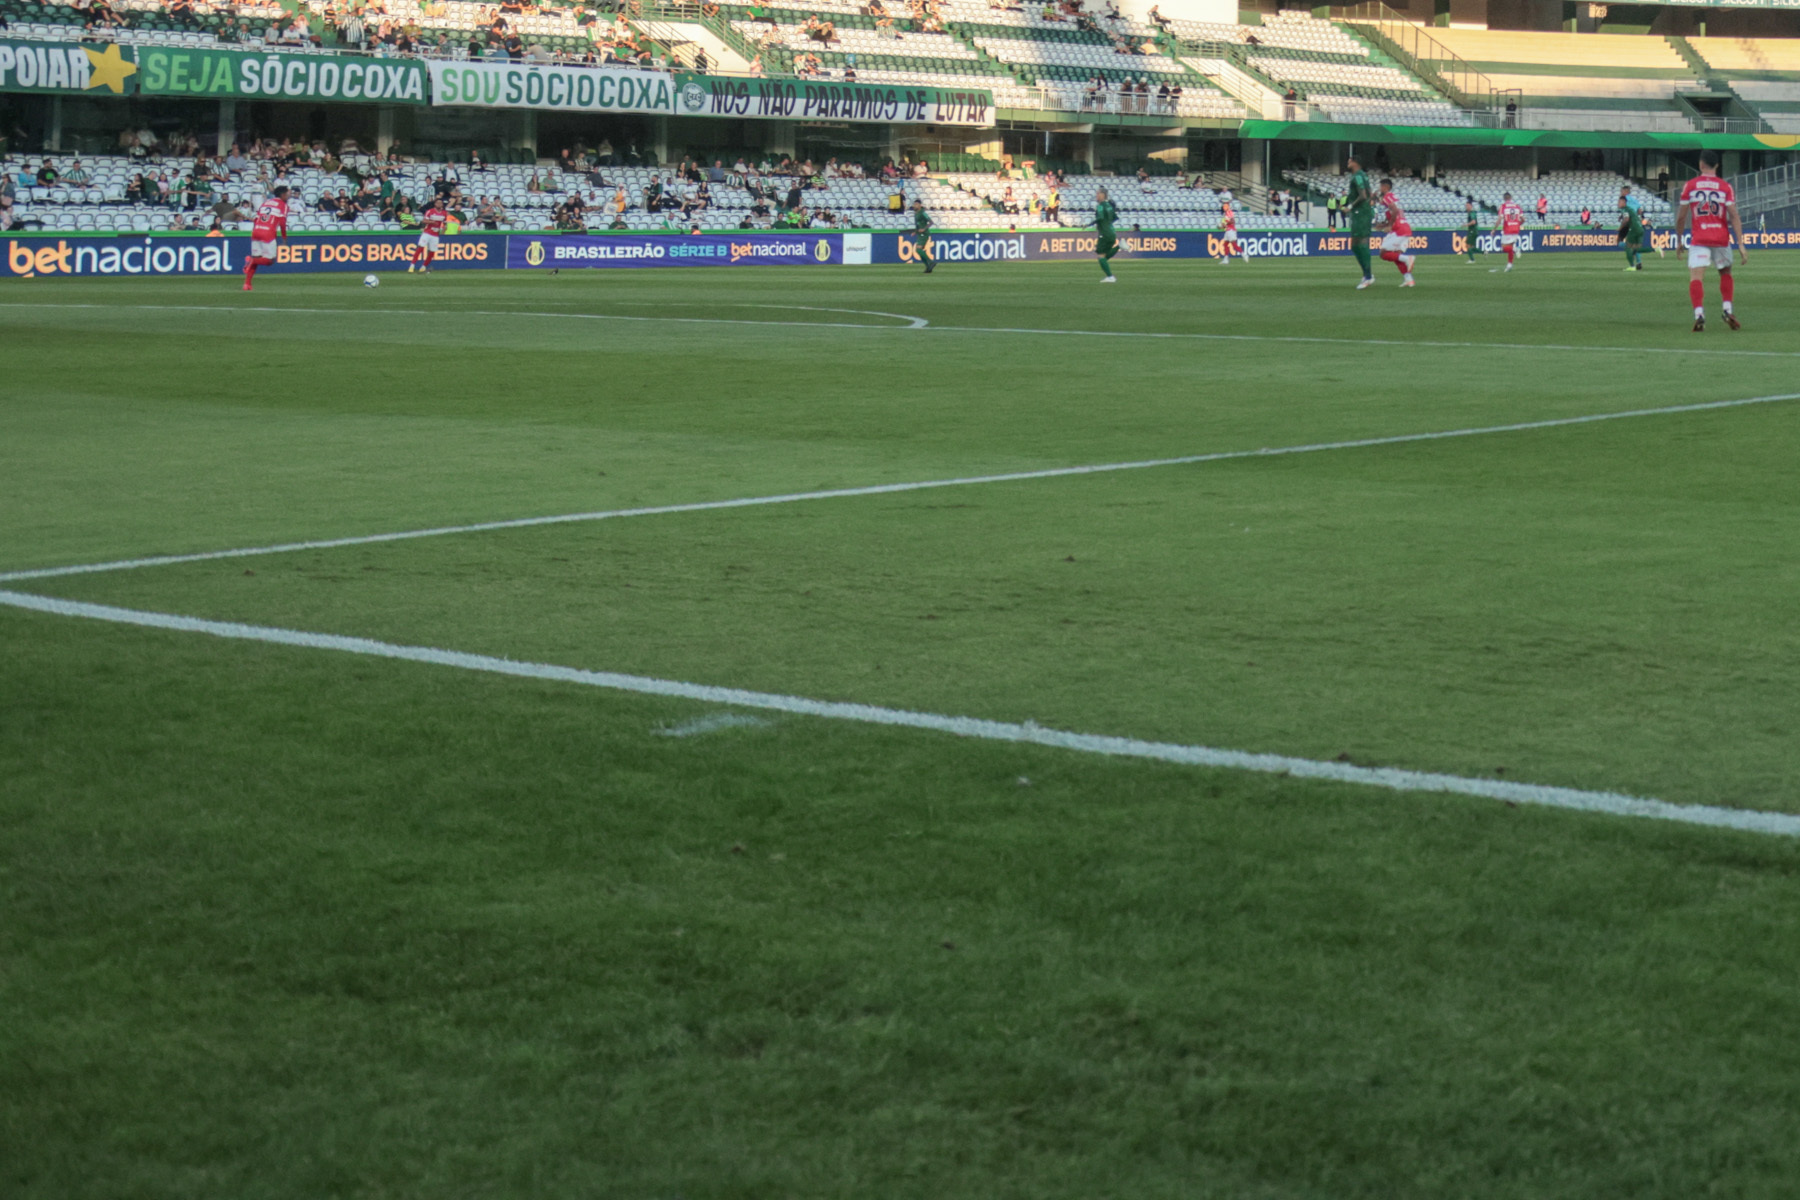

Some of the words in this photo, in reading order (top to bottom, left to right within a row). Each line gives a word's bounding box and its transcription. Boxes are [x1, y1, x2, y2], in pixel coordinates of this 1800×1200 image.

[145, 53, 235, 93] SEJA
[441, 68, 501, 104] SOU
[758, 79, 796, 116] NÃO
[803, 85, 898, 120] PARAMOS
[905, 91, 928, 120] DE
[935, 92, 988, 123] LUTAR
[1695, 191, 1720, 215] 26
[261, 207, 272, 222] 3
[1040, 238, 1049, 253] A
[1051, 238, 1074, 253] BET
[1318, 237, 1327, 251] A
[1327, 237, 1347, 250] BET
[1541, 234, 1549, 246] A
[1549, 234, 1565, 246] BET
[1566, 234, 1583, 246] DOS
[1760, 233, 1785, 245] DOS
[8, 237, 232, 278] betnacional
[277, 245, 317, 263] BET
[320, 244, 363, 262] DOS
[554, 242, 665, 259] BRASILEIRÃO
[669, 242, 715, 258] SÉRIE
[718, 246, 727, 257] B
[731, 241, 807, 262] betnacional
